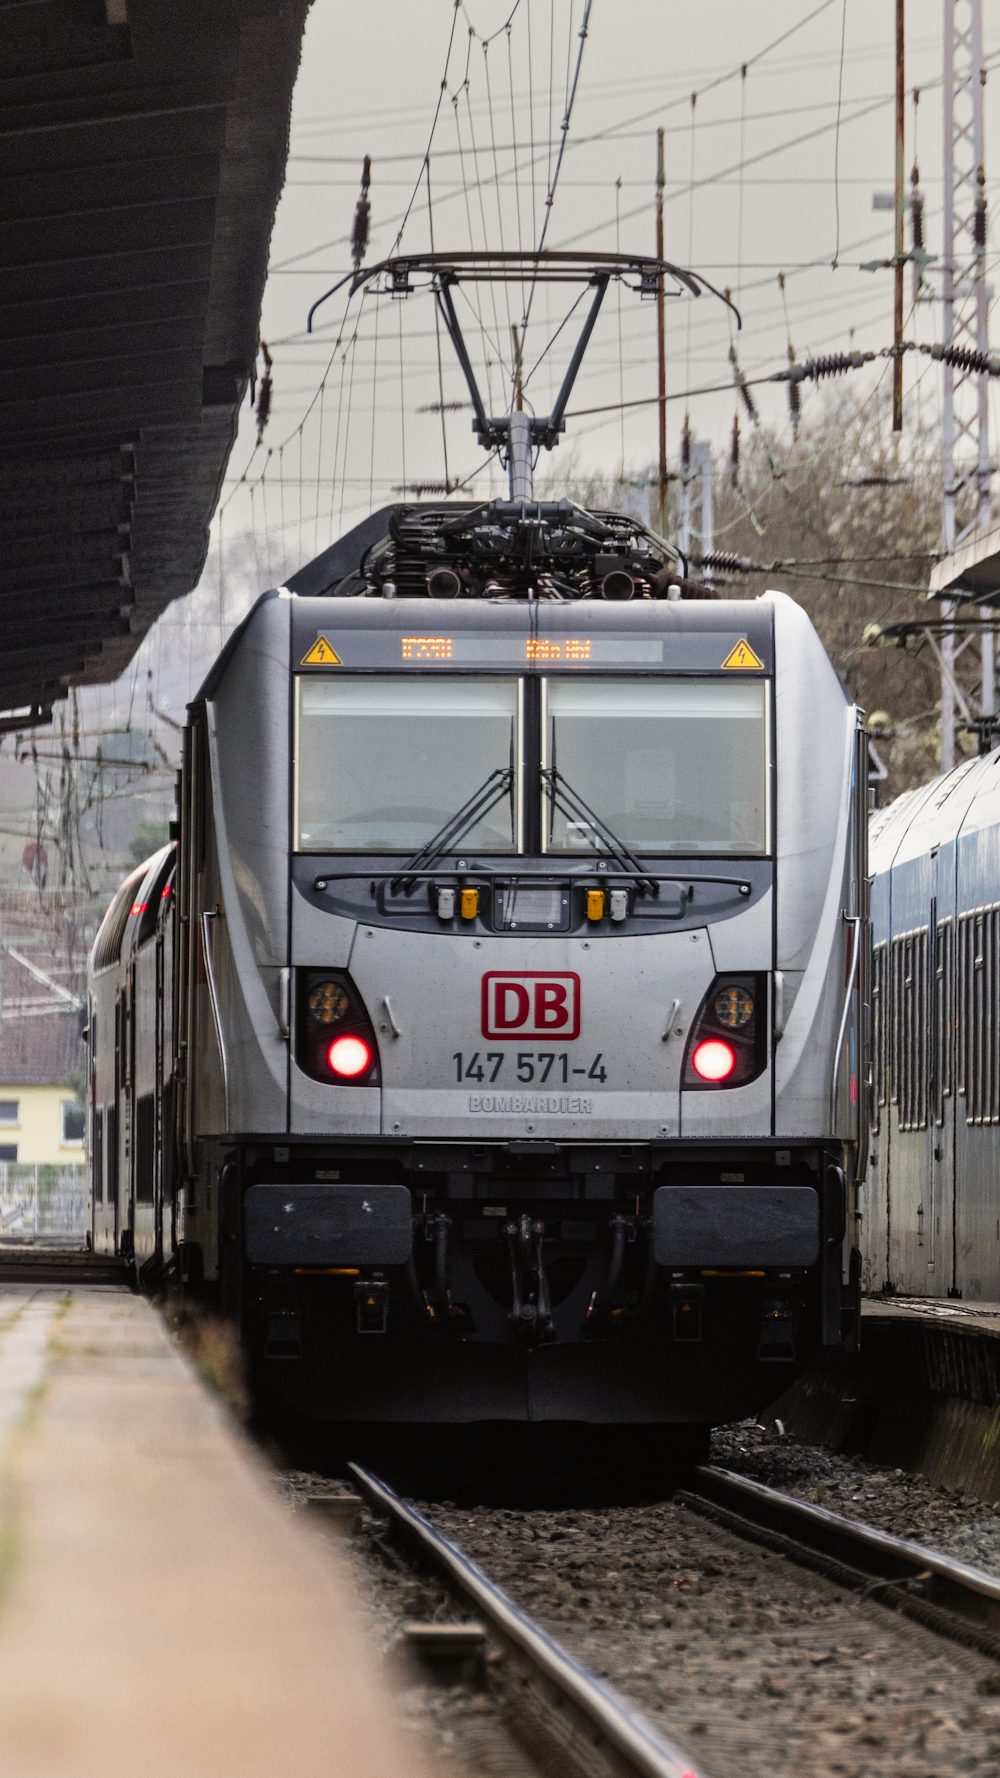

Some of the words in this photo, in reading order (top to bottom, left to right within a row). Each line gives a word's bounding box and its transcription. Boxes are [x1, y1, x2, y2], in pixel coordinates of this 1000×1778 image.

[494, 982, 569, 1029] DB
[452, 1052, 505, 1083] 147
[516, 1052, 608, 1084] 571-4
[469, 1096, 593, 1114] BOMBARDIER
